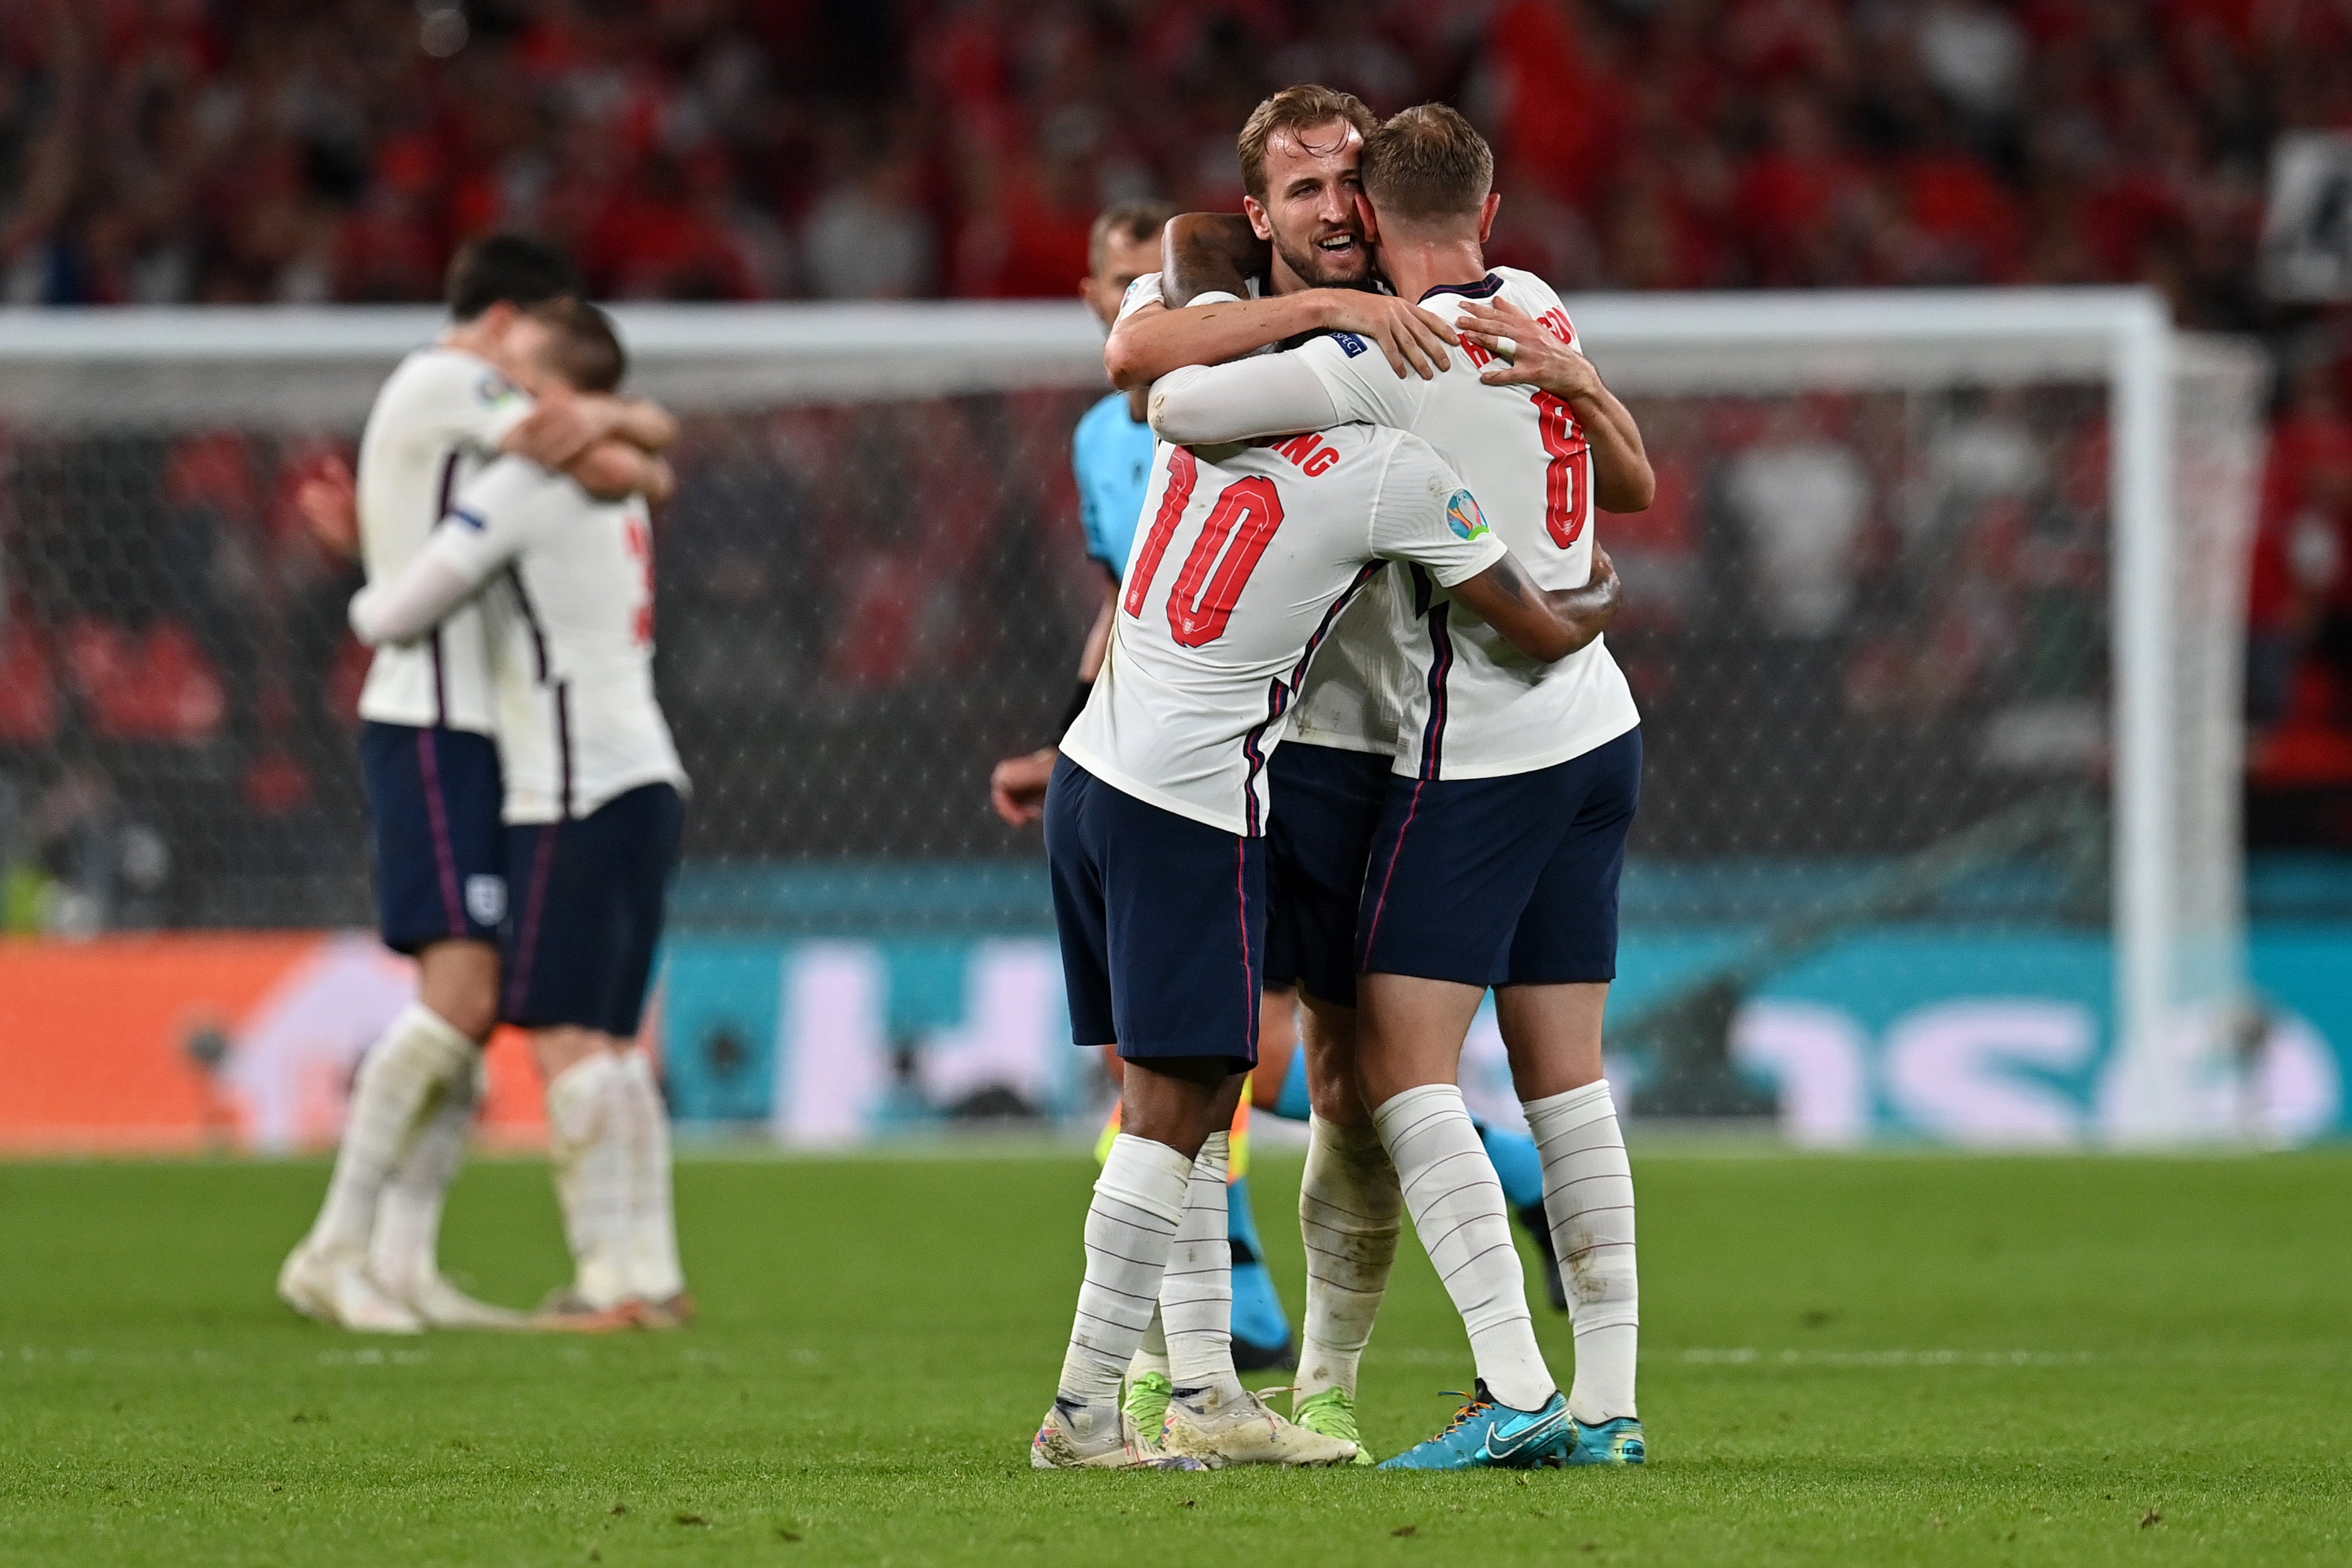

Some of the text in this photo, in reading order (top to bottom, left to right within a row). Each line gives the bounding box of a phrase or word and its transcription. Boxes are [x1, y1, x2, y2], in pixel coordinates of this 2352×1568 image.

[1328, 332, 1363, 354] SPECT
[1123, 444, 1285, 649] 10
[1530, 388, 1588, 550] 8
